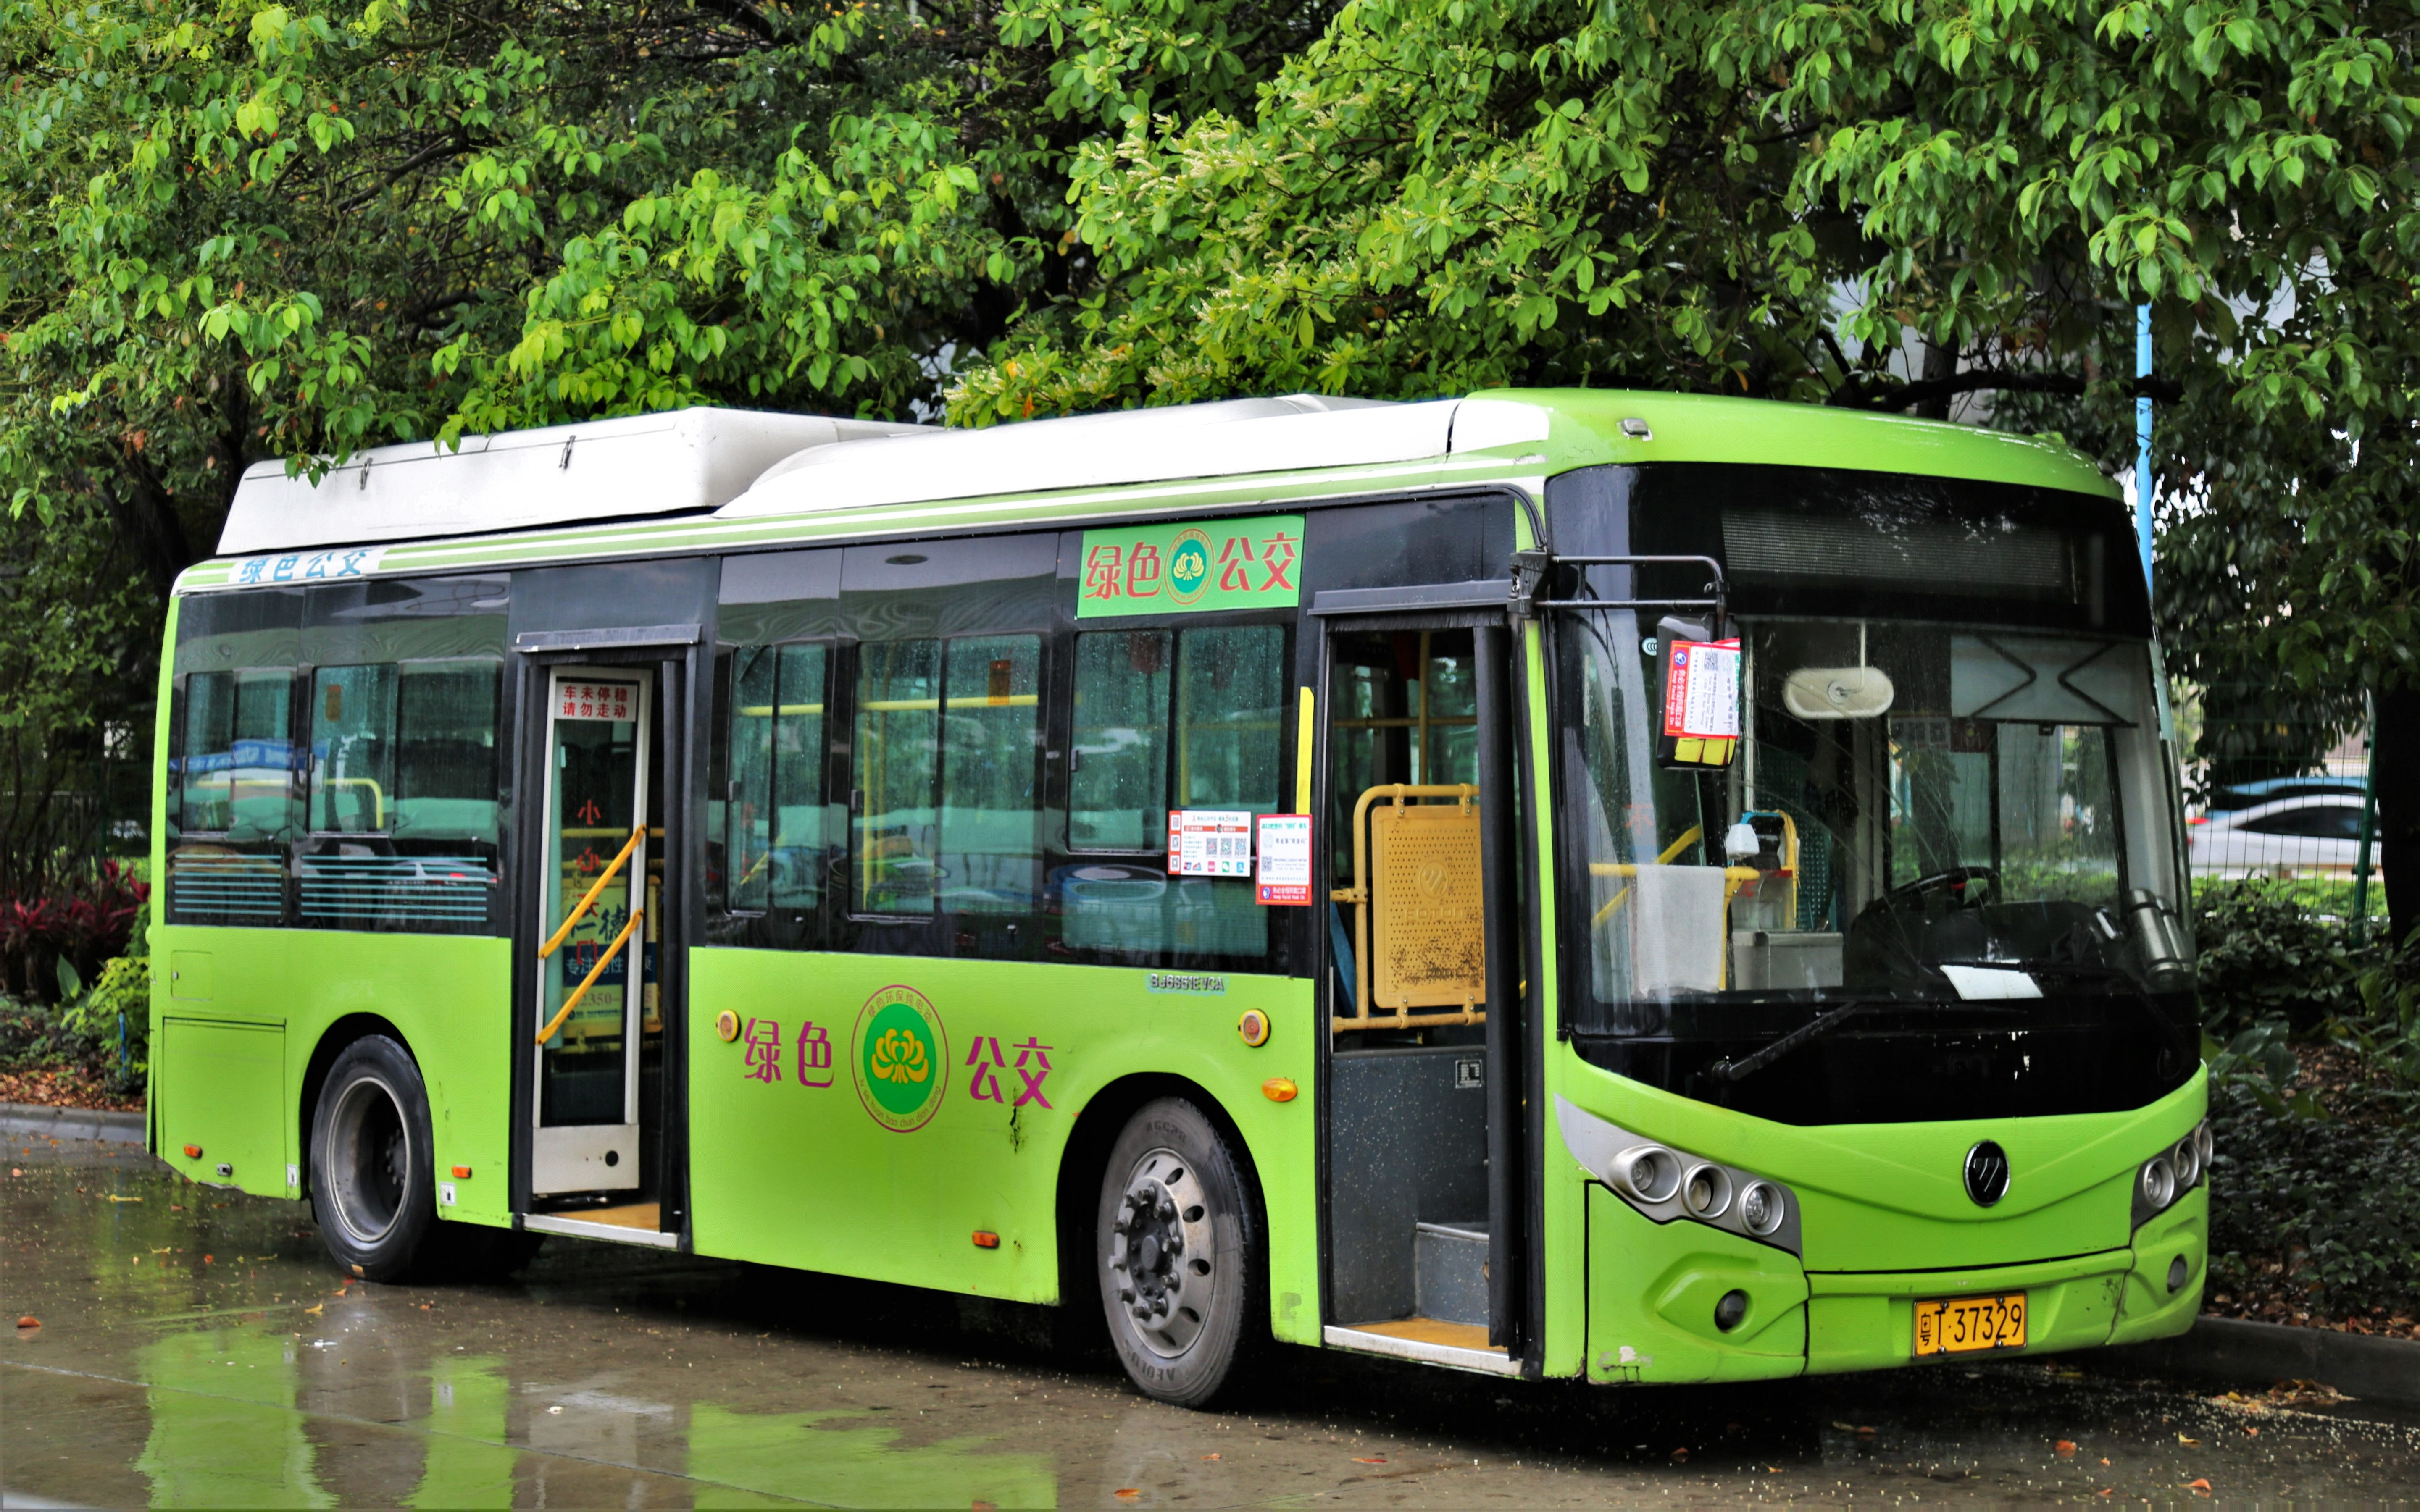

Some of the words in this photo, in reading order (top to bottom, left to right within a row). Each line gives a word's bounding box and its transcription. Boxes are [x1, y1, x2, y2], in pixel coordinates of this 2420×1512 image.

[239, 547, 375, 584] 绿色公交
[1085, 541, 1162, 599] 绿色
[1218, 532, 1299, 592] 公交
[563, 685, 627, 702] 车未停稳
[563, 701, 626, 718] 请勿走动
[743, 1017, 834, 1088] 绿色
[965, 1036, 1054, 1110] 公交
